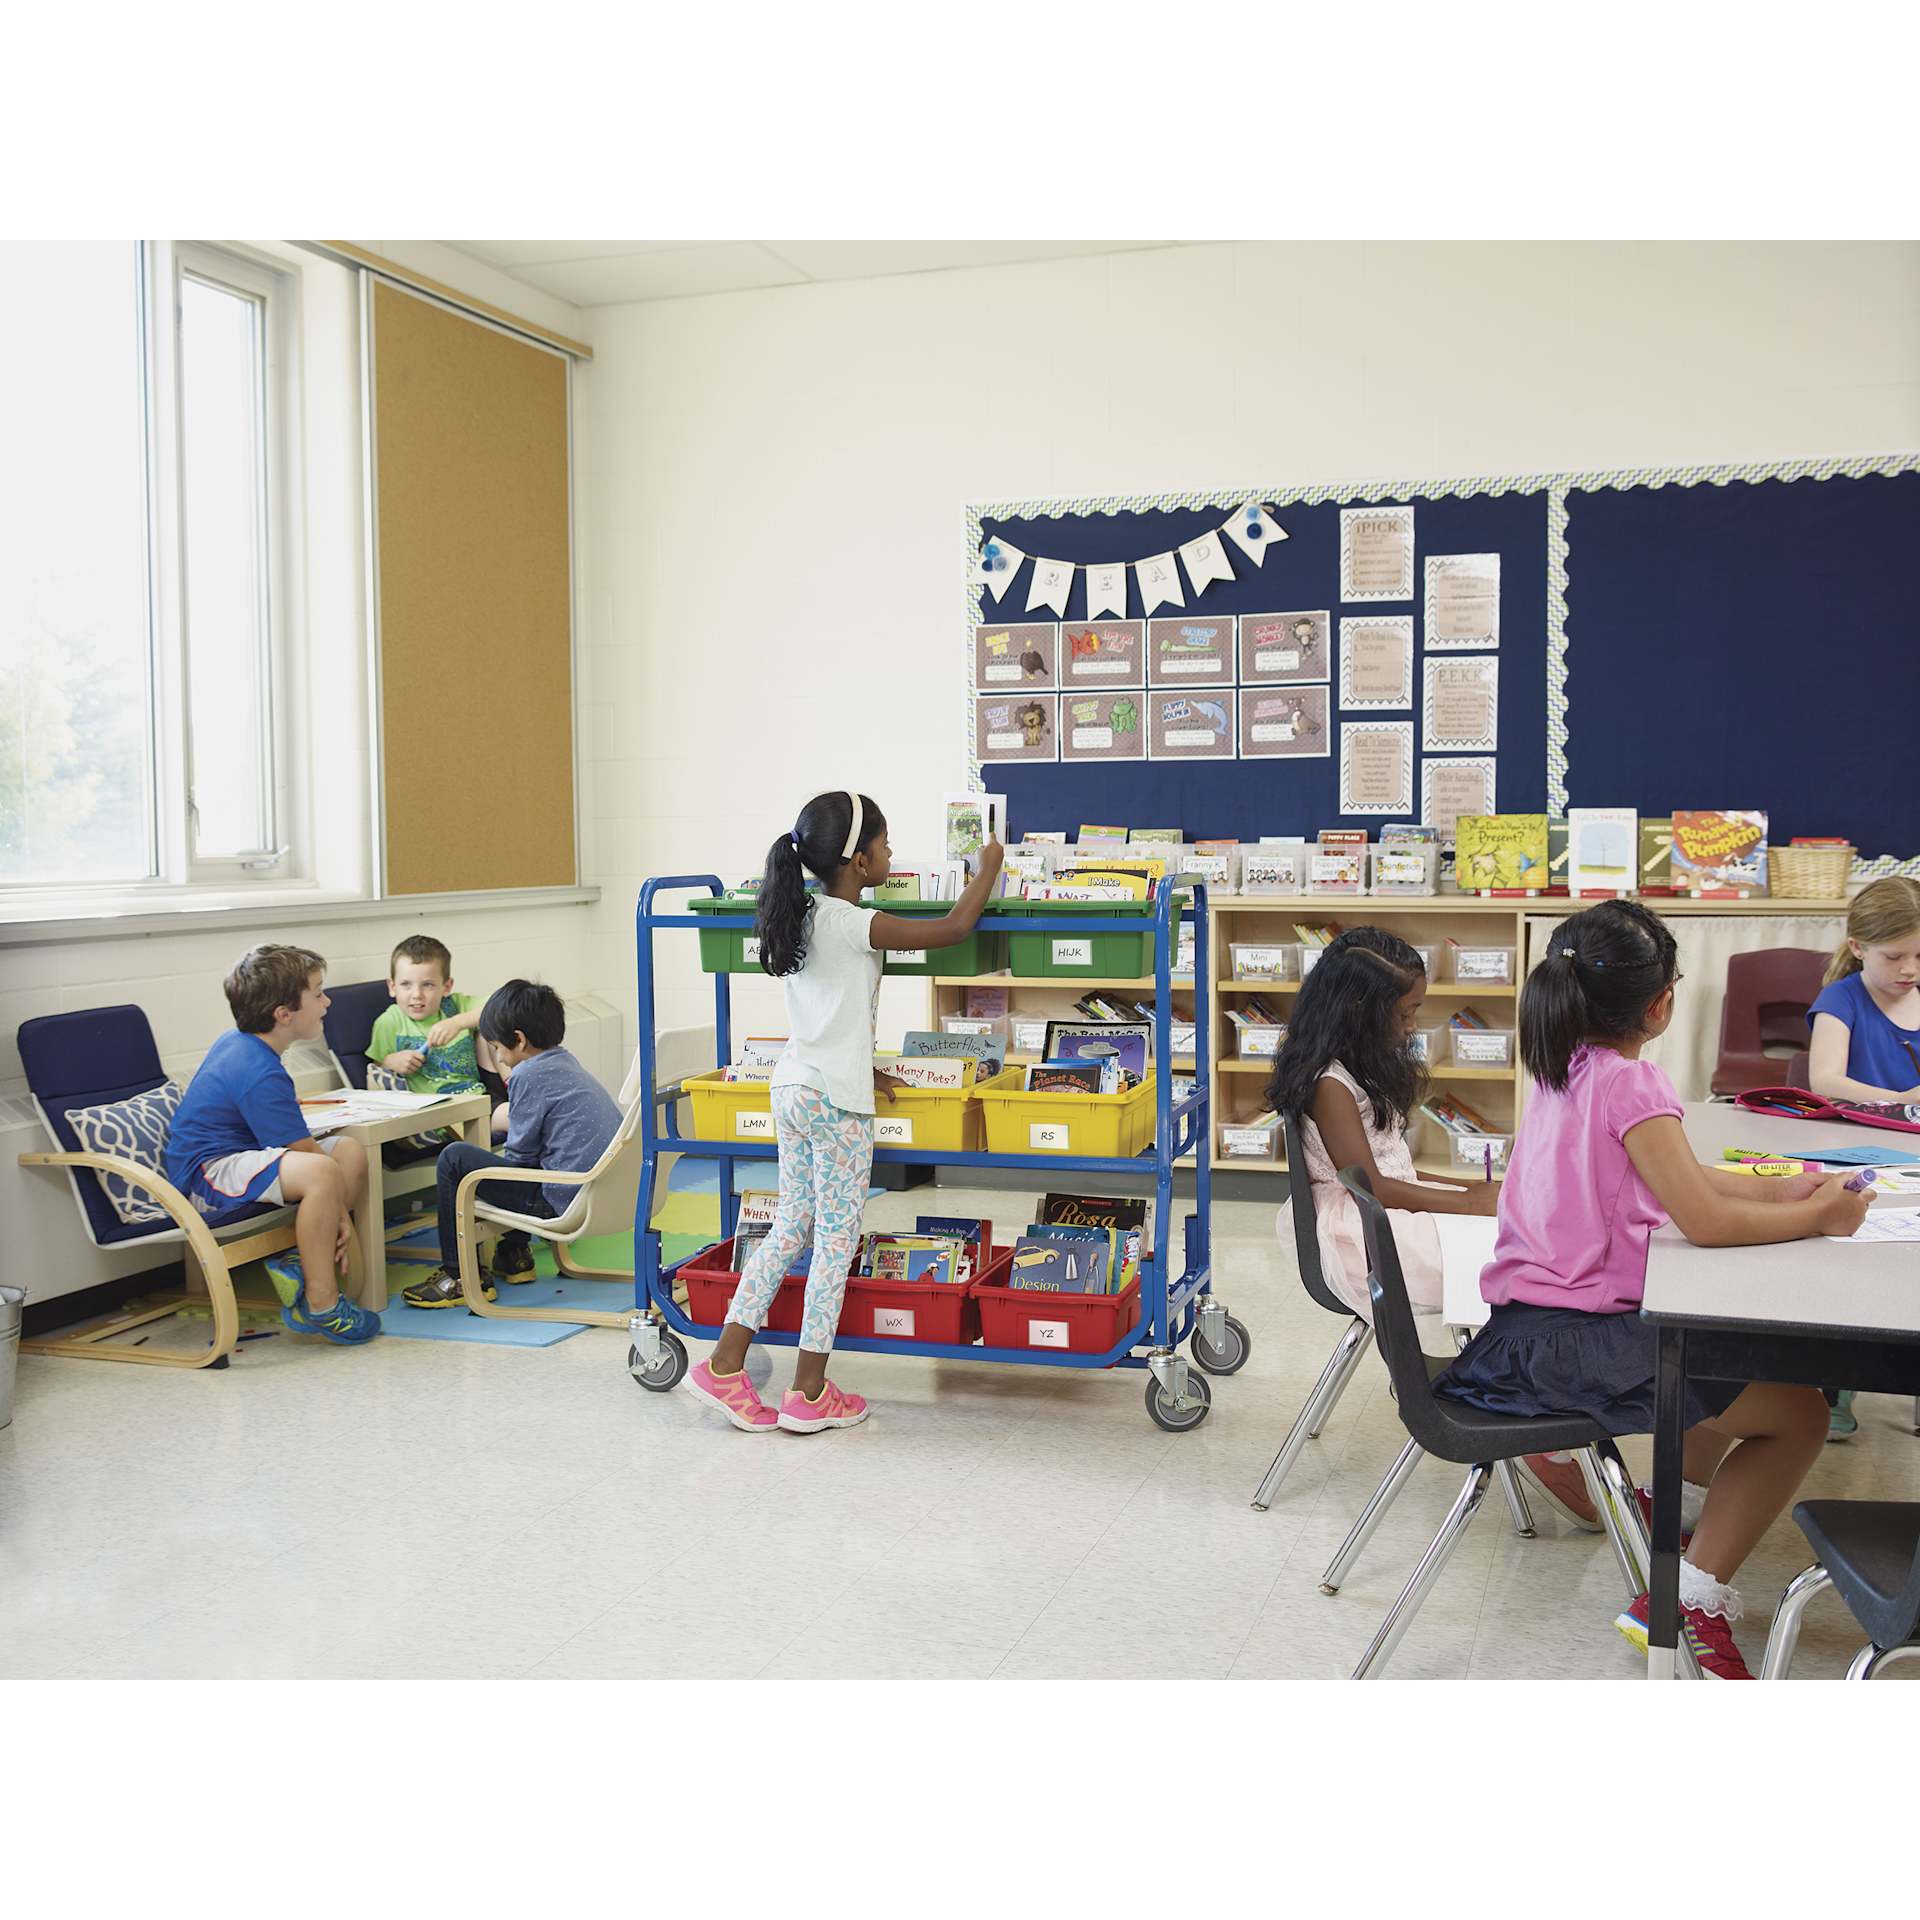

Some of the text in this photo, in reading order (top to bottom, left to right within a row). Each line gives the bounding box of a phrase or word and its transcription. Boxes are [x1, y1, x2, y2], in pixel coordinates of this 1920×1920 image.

[1478, 831, 1525, 843] Present?
[1682, 825, 1762, 860] Pumpkin
[885, 880, 909, 889] Under
[1094, 877, 1121, 887] Make
[1058, 948, 1082, 957] HIJK
[919, 1037, 987, 1057] Butterflies
[896, 1064, 925, 1079] Many
[927, 1071, 957, 1085] Pets?
[1034, 1074, 1067, 1088] Planet
[743, 1120, 767, 1128] LMN
[879, 1126, 903, 1136] OPQ
[1040, 1132, 1055, 1141] RS
[743, 1208, 772, 1220] WHEN
[1014, 1277, 1060, 1292] Design
[885, 1318, 903, 1327] WX
[1040, 1329, 1055, 1338] YZ
